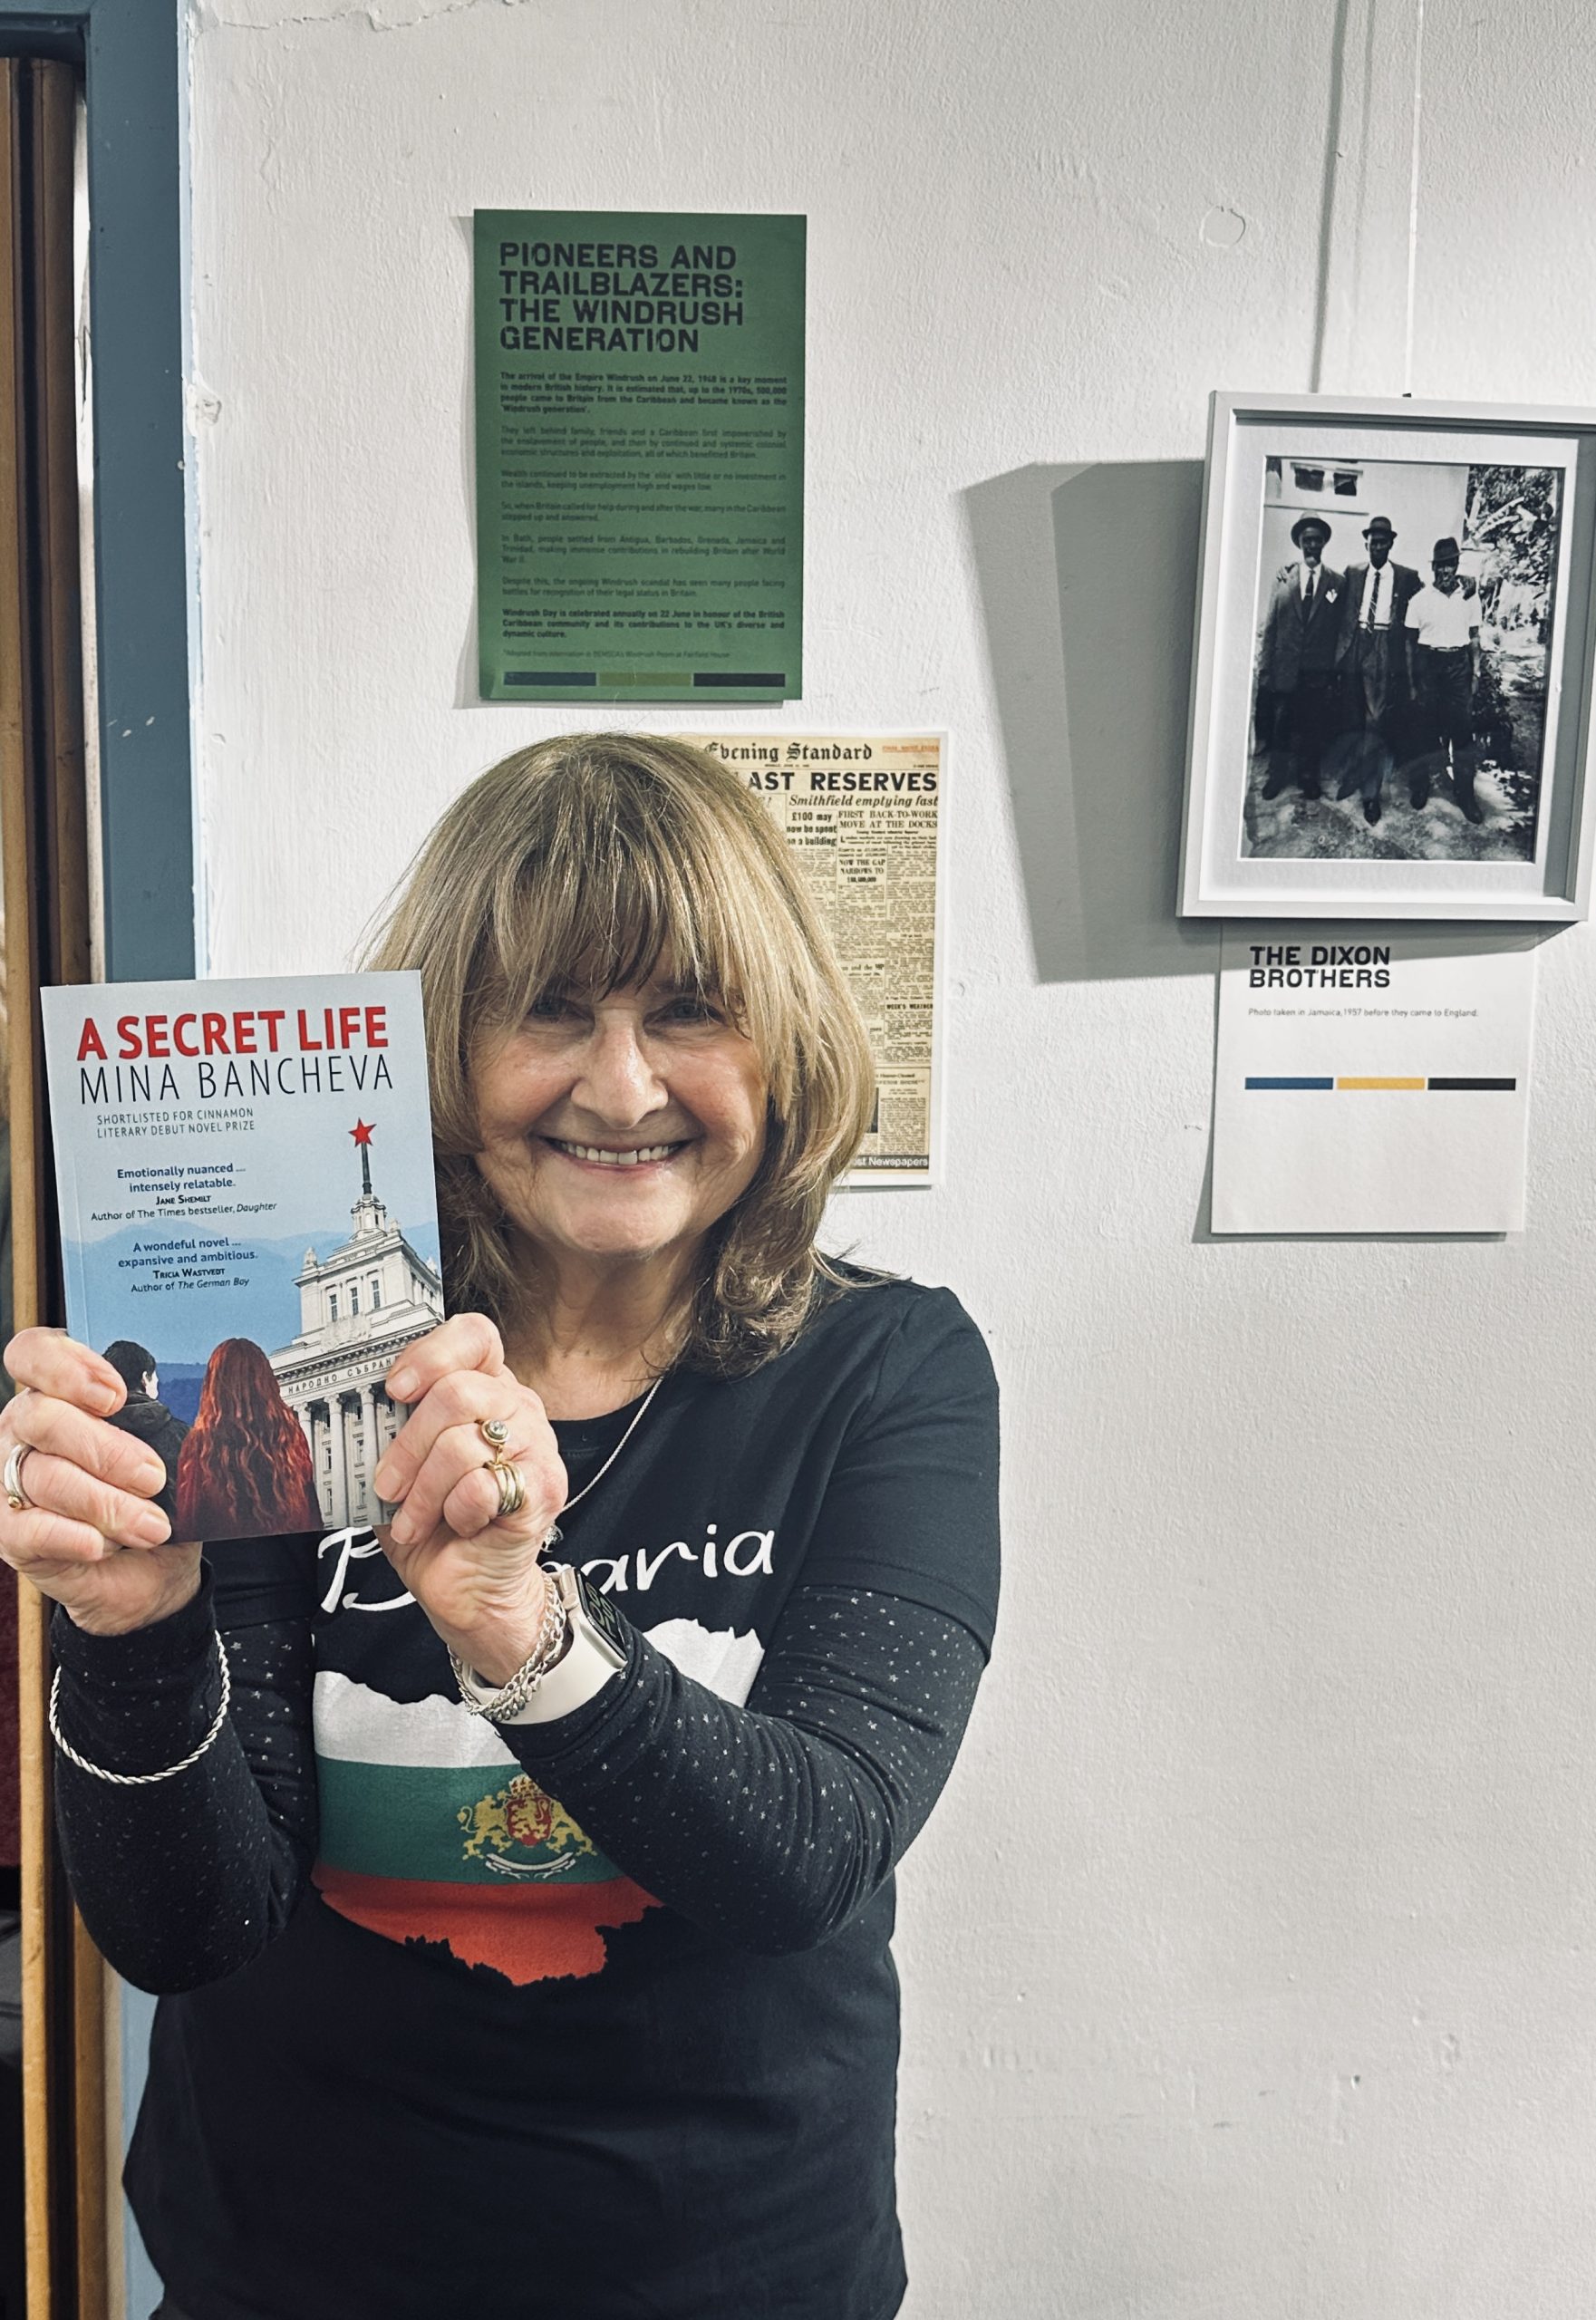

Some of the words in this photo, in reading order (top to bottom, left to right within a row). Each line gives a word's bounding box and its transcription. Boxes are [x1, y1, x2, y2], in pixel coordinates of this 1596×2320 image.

[500, 242, 658, 268] PIONEERS
[670, 245, 736, 270] AND
[498, 270, 742, 298] TRAILBLAZERS:
[499, 298, 560, 323] THE
[573, 298, 742, 325] WINDRUSH
[500, 325, 698, 353] GENERATION
[705, 741, 779, 762] Evening
[787, 742, 872, 761] Standard
[749, 771, 795, 791] AST
[810, 772, 936, 791] RESERVES
[788, 794, 854, 806] Smithfield
[855, 795, 913, 808] emptying
[915, 795, 937, 807] fast
[1250, 946, 1301, 965] THE
[1311, 945, 1390, 965] DIXON
[1250, 968, 1389, 988] BROTHERS
[1248, 1008, 1272, 1016] Photo
[1363, 1009, 1389, 1017] before
[1391, 1009, 1408, 1018] they
[1444, 1008, 1478, 1019] England.
[76, 1018, 108, 1061] A
[117, 1010, 285, 1059] SECRET
[297, 1006, 388, 1051] LIFE
[81, 1063, 179, 1105] MINA
[198, 1054, 392, 1098] BANCHEVA
[97, 1111, 169, 1125] SHORTLISTED
[173, 1110, 193, 1121] FOR
[197, 1107, 253, 1120] CINNAMON
[97, 1126, 147, 1138] LITERARY
[150, 1124, 185, 1136] DEBUT
[189, 1122, 222, 1133] NOVEL
[225, 1120, 254, 1131] PRIZE
[117, 1165, 184, 1178] Emotionally
[187, 1163, 233, 1174] nuanced
[869, 1156, 928, 1167] Newspapers
[130, 1181, 180, 1193] intensely
[183, 1177, 236, 1189] relatable.
[91, 1212, 122, 1221] Author
[125, 1210, 135, 1219] of
[137, 1209, 155, 1218] The
[157, 1208, 186, 1216] Times
[188, 1205, 235, 1215] bestseller,
[236, 1203, 276, 1213] Daughter
[132, 1242, 141, 1252] A
[143, 1239, 196, 1252] wondeful
[198, 1237, 229, 1248] novel
[118, 1255, 174, 1269] expansive
[177, 1253, 197, 1263] and
[200, 1251, 257, 1262] ambitious.
[131, 1283, 162, 1292] Author
[165, 1281, 175, 1290] of
[178, 1281, 194, 1290] The
[197, 1279, 230, 1289] German
[233, 1277, 249, 1287] Boy
[288, 1374, 338, 1394] НАРОДНО
[347, 1357, 400, 1377] СЪБРАН
[318, 1524, 775, 1612] Baria
